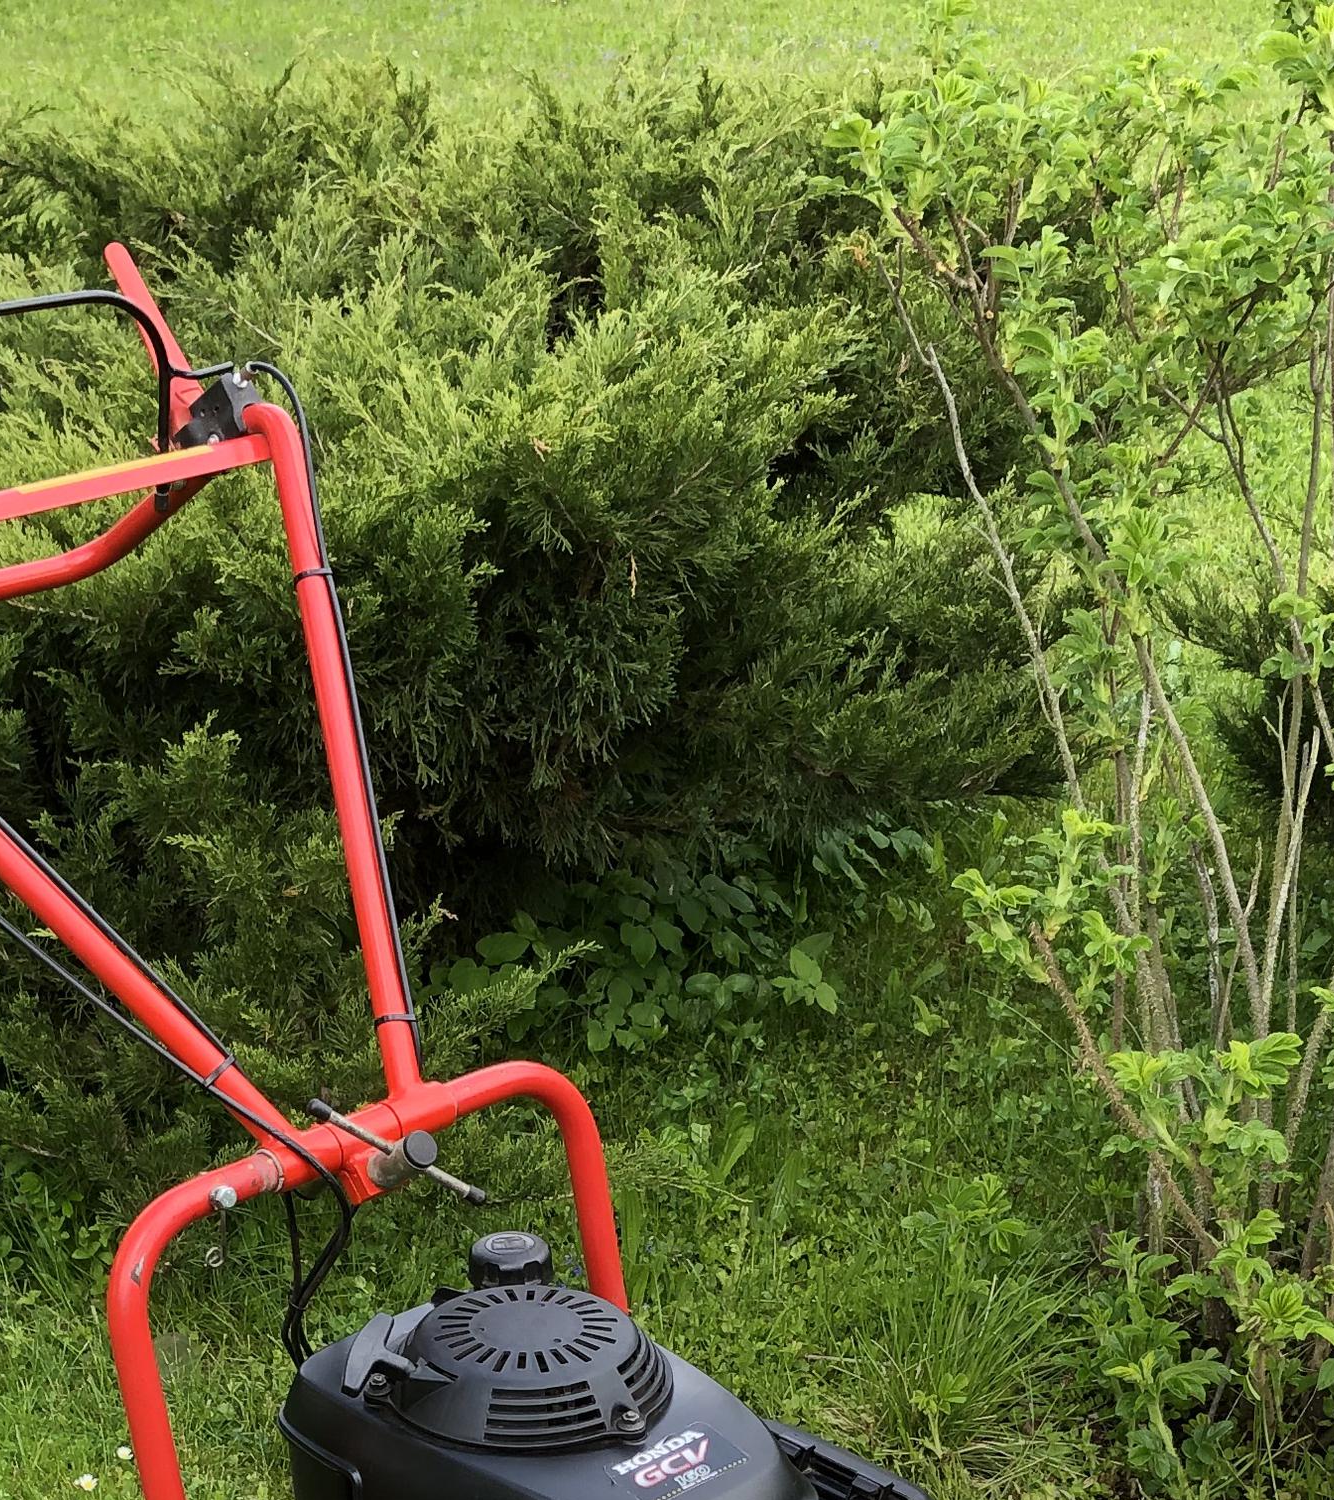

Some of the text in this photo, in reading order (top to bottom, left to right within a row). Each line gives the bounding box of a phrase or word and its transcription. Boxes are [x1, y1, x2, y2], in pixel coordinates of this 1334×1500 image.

[611, 1430, 705, 1475] HONDA
[633, 1438, 709, 1488] GCV
[673, 1463, 711, 1488] 160
